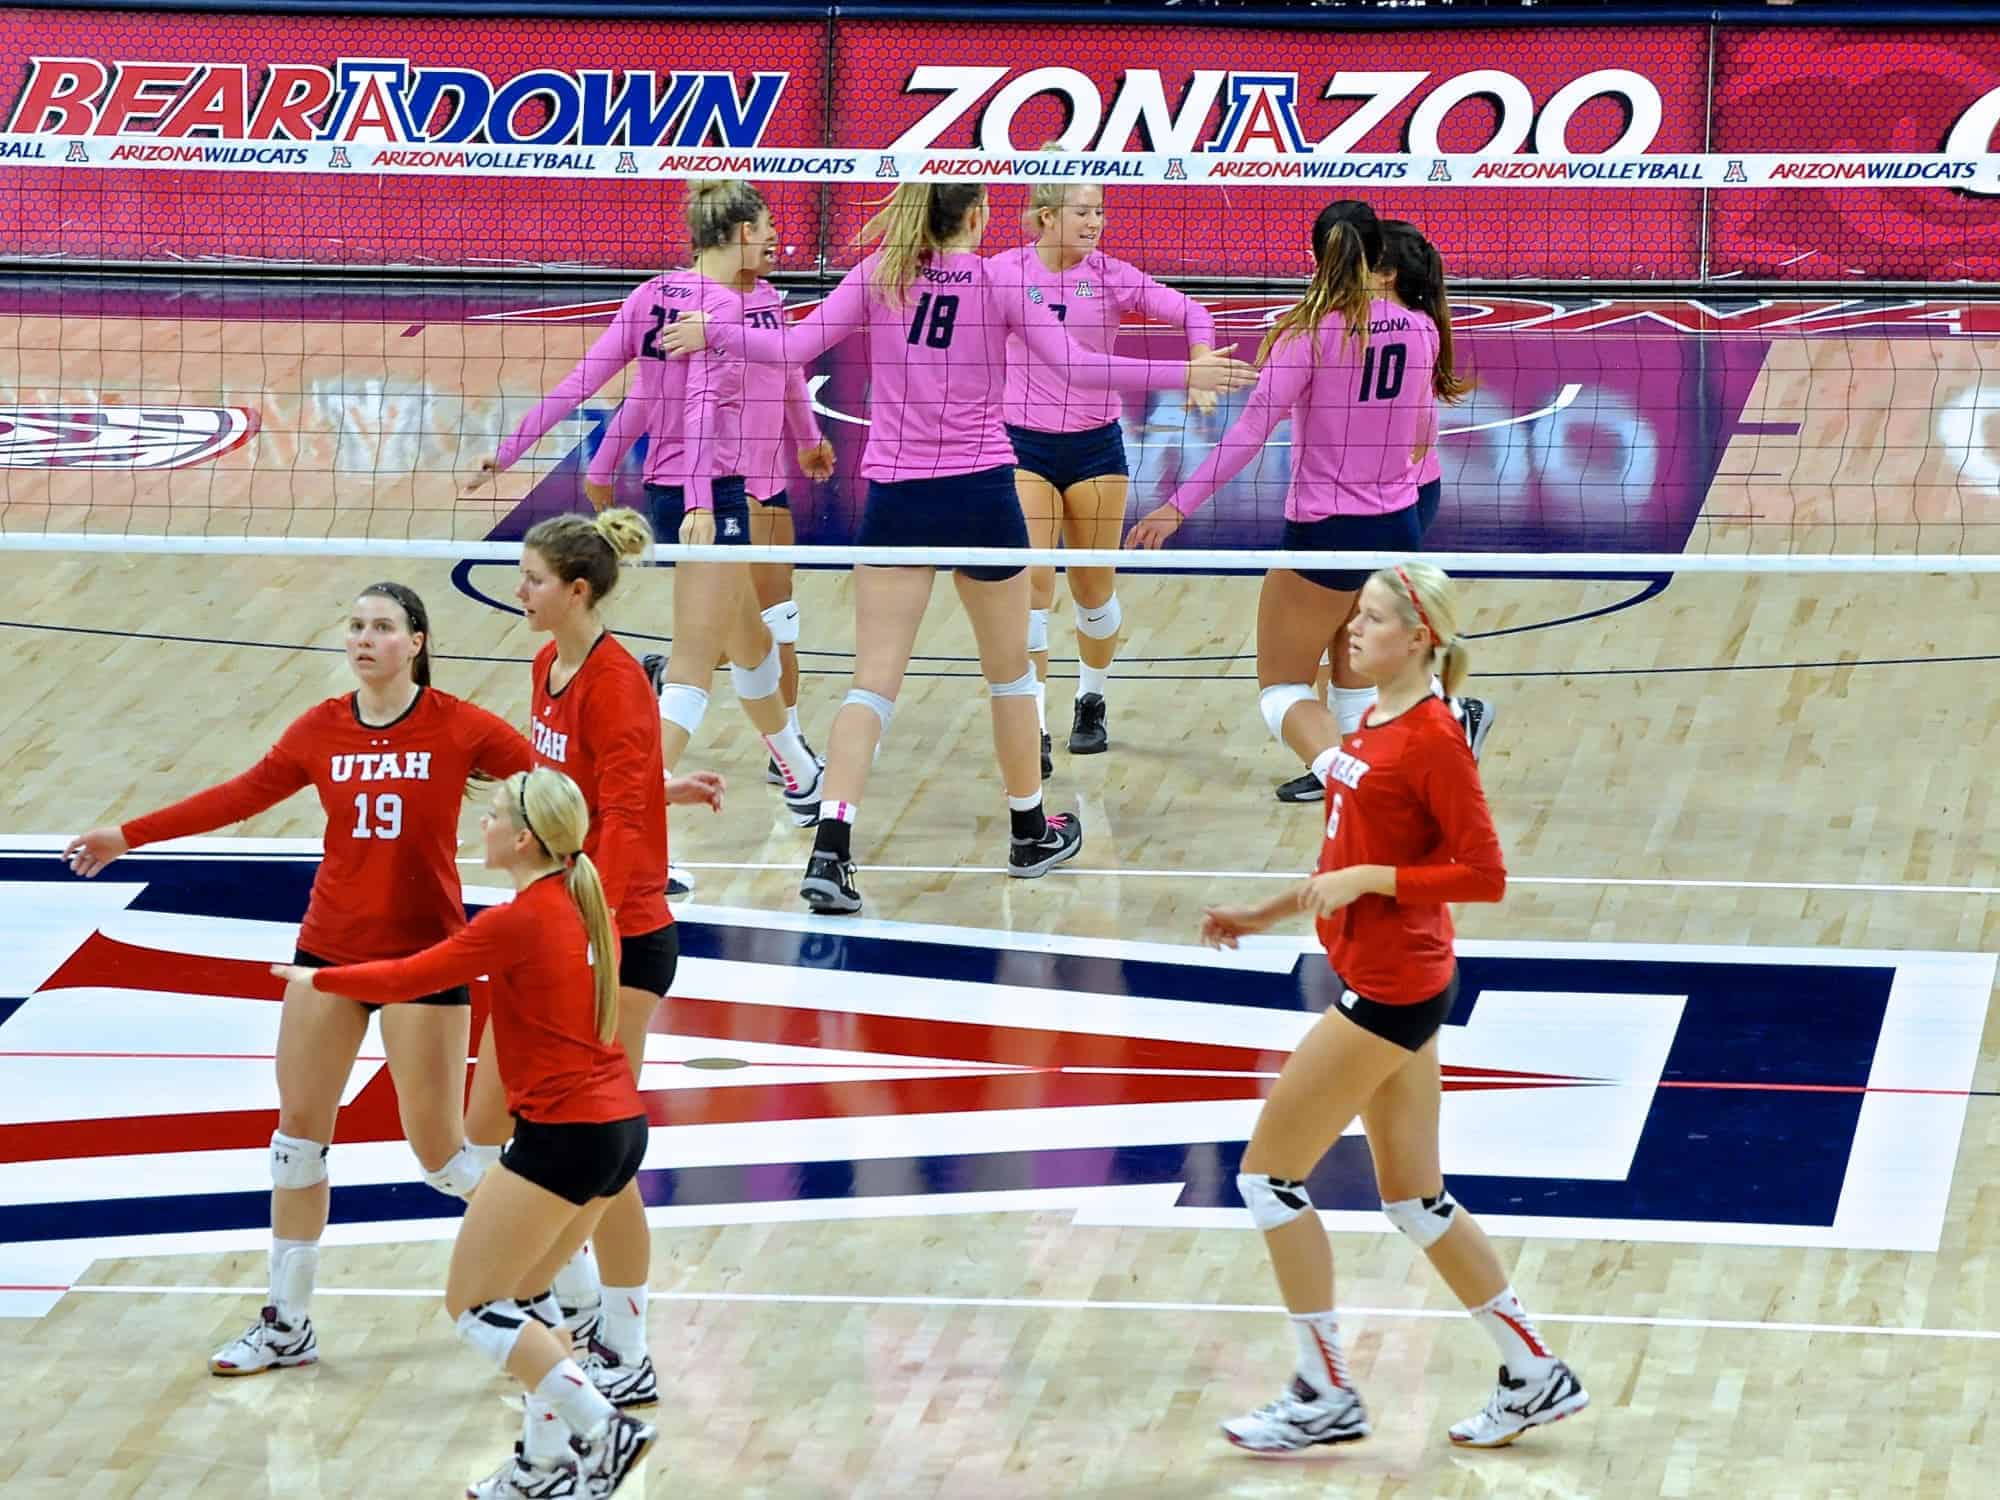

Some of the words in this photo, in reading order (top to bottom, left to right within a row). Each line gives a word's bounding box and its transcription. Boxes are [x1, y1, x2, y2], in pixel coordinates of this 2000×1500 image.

[907, 292, 960, 349] 18
[1350, 317, 1410, 336] AIZONA
[1358, 343, 1407, 402] 10
[531, 716, 568, 763] TAH
[330, 751, 432, 782] UTAH
[351, 792, 403, 839] 19
